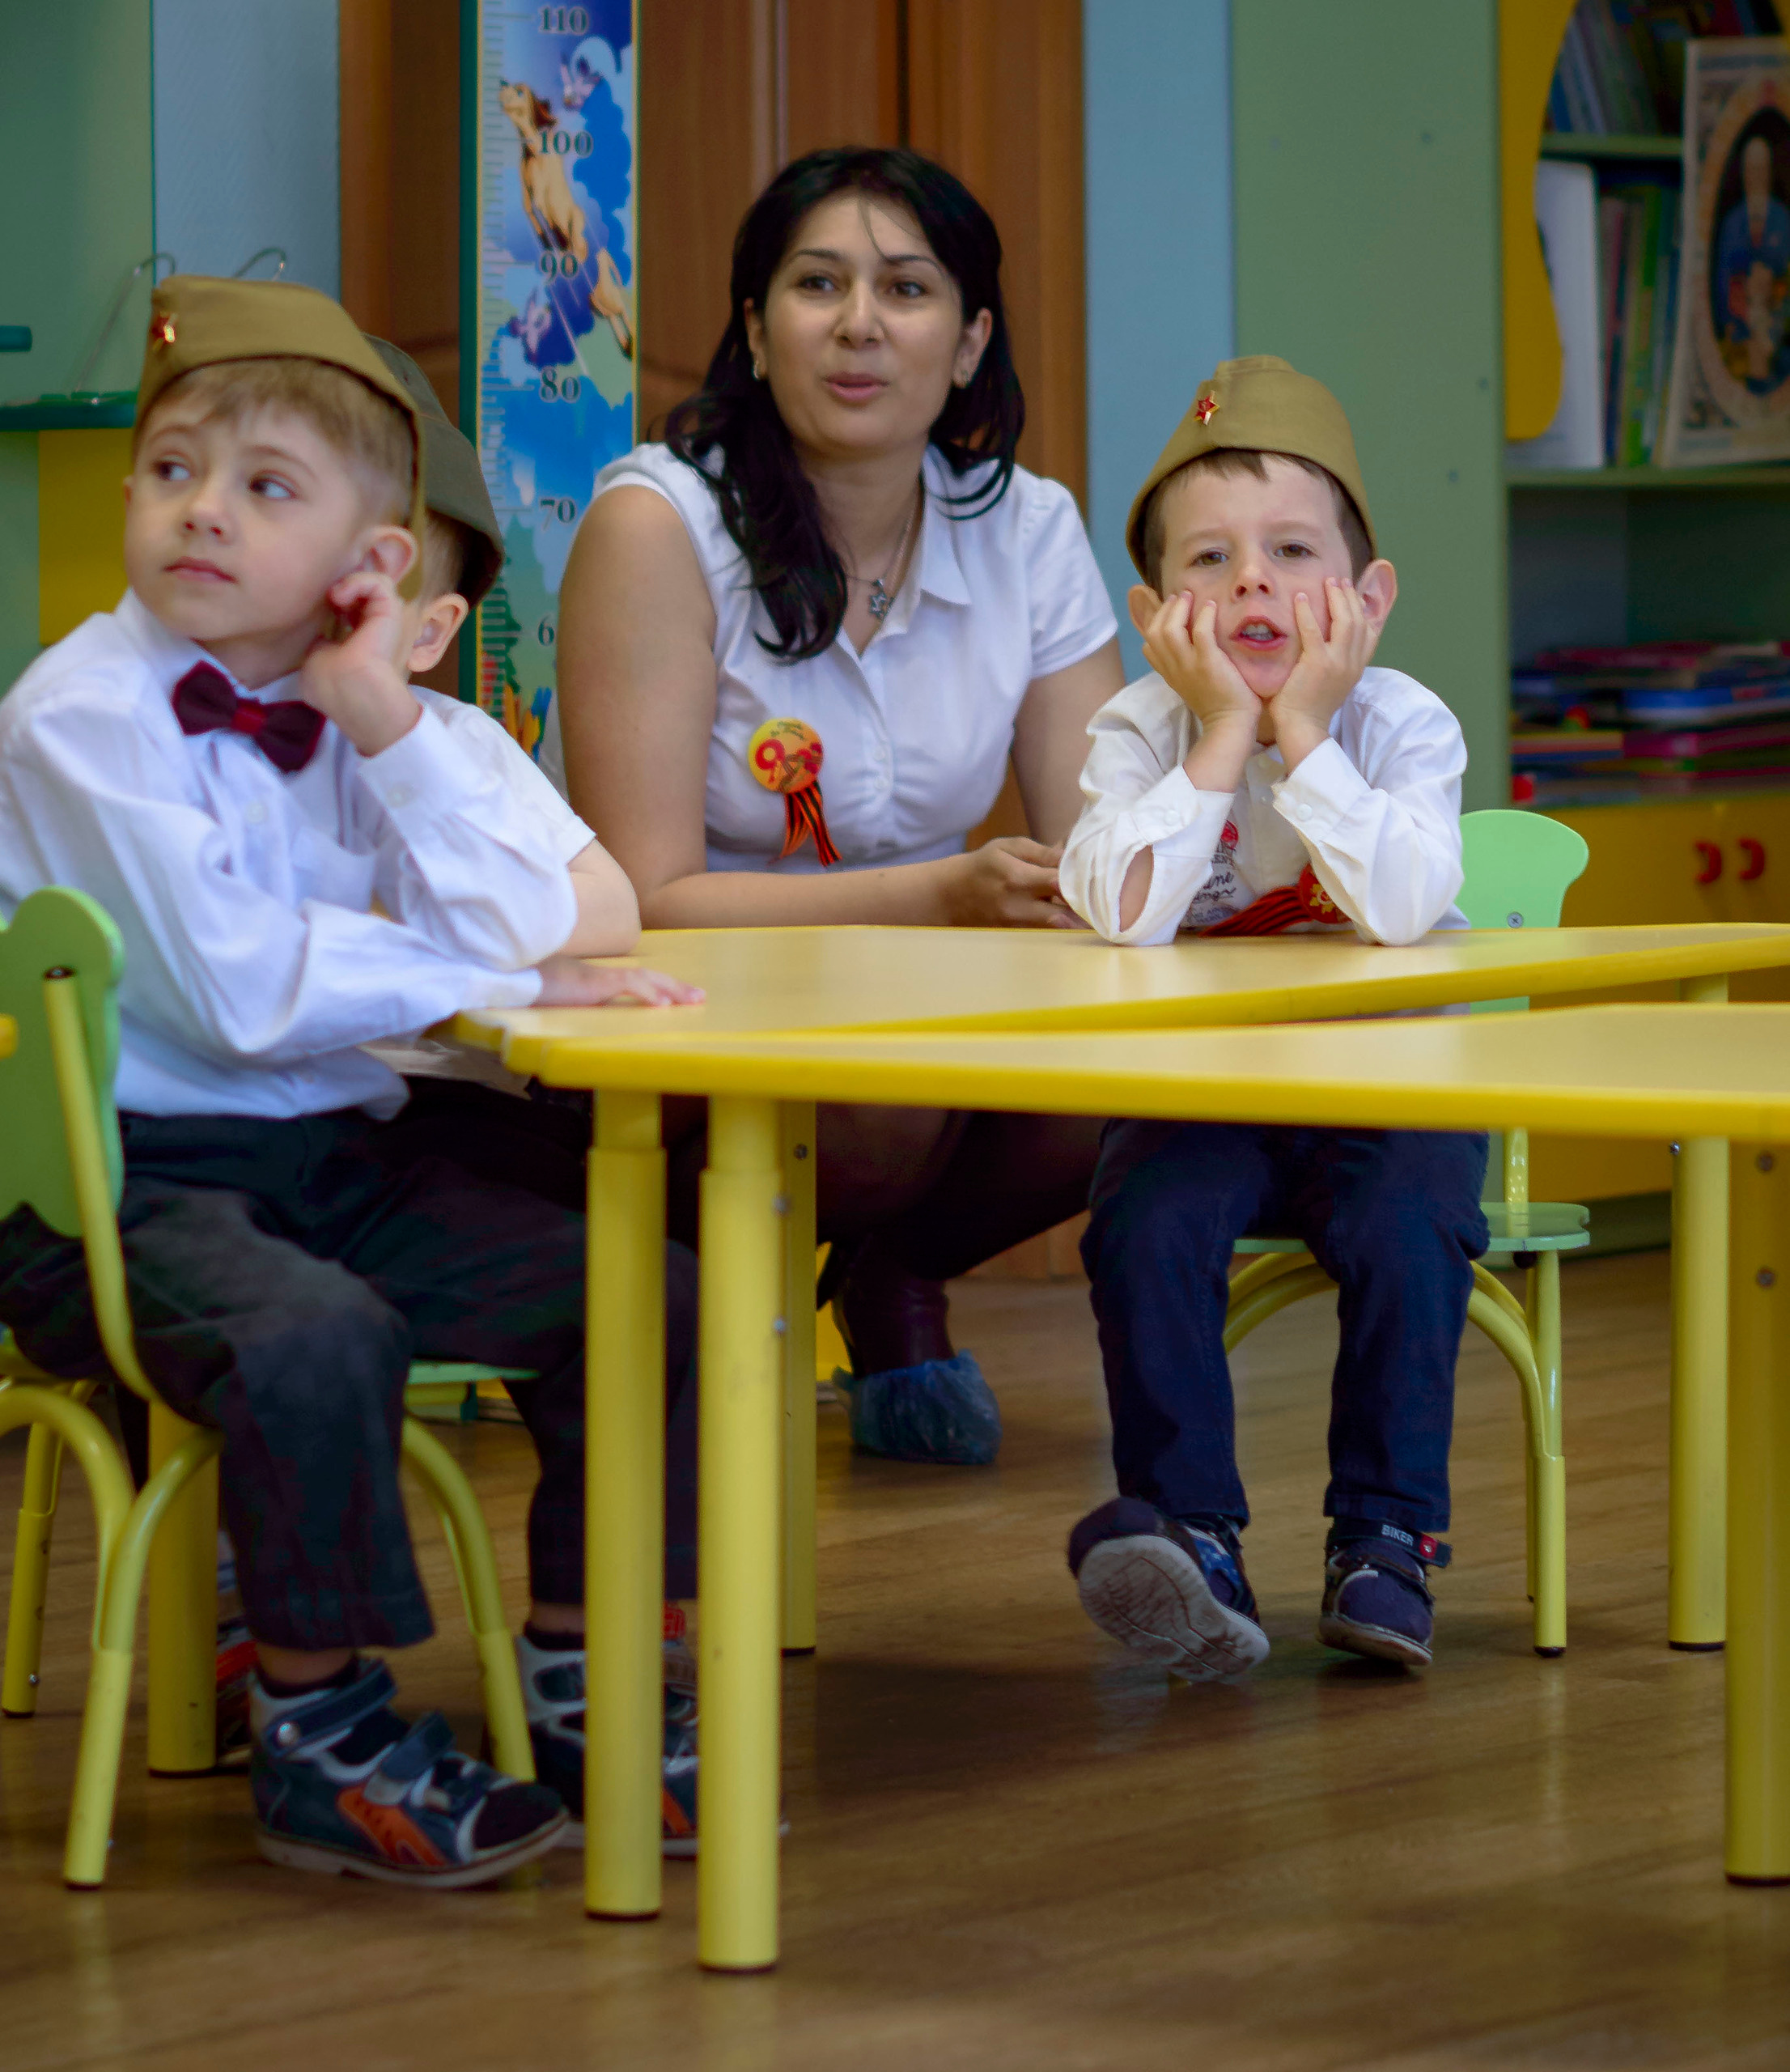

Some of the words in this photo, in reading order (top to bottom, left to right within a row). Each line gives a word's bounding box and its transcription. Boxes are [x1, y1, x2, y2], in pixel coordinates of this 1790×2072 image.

[541, 7, 587, 32] 110
[540, 130, 592, 156] 100
[541, 253, 579, 281] 90
[540, 367, 580, 401] 80
[540, 499, 575, 529] 70
[537, 615, 557, 647] 6
[1381, 1524, 1415, 1547] BIKER
